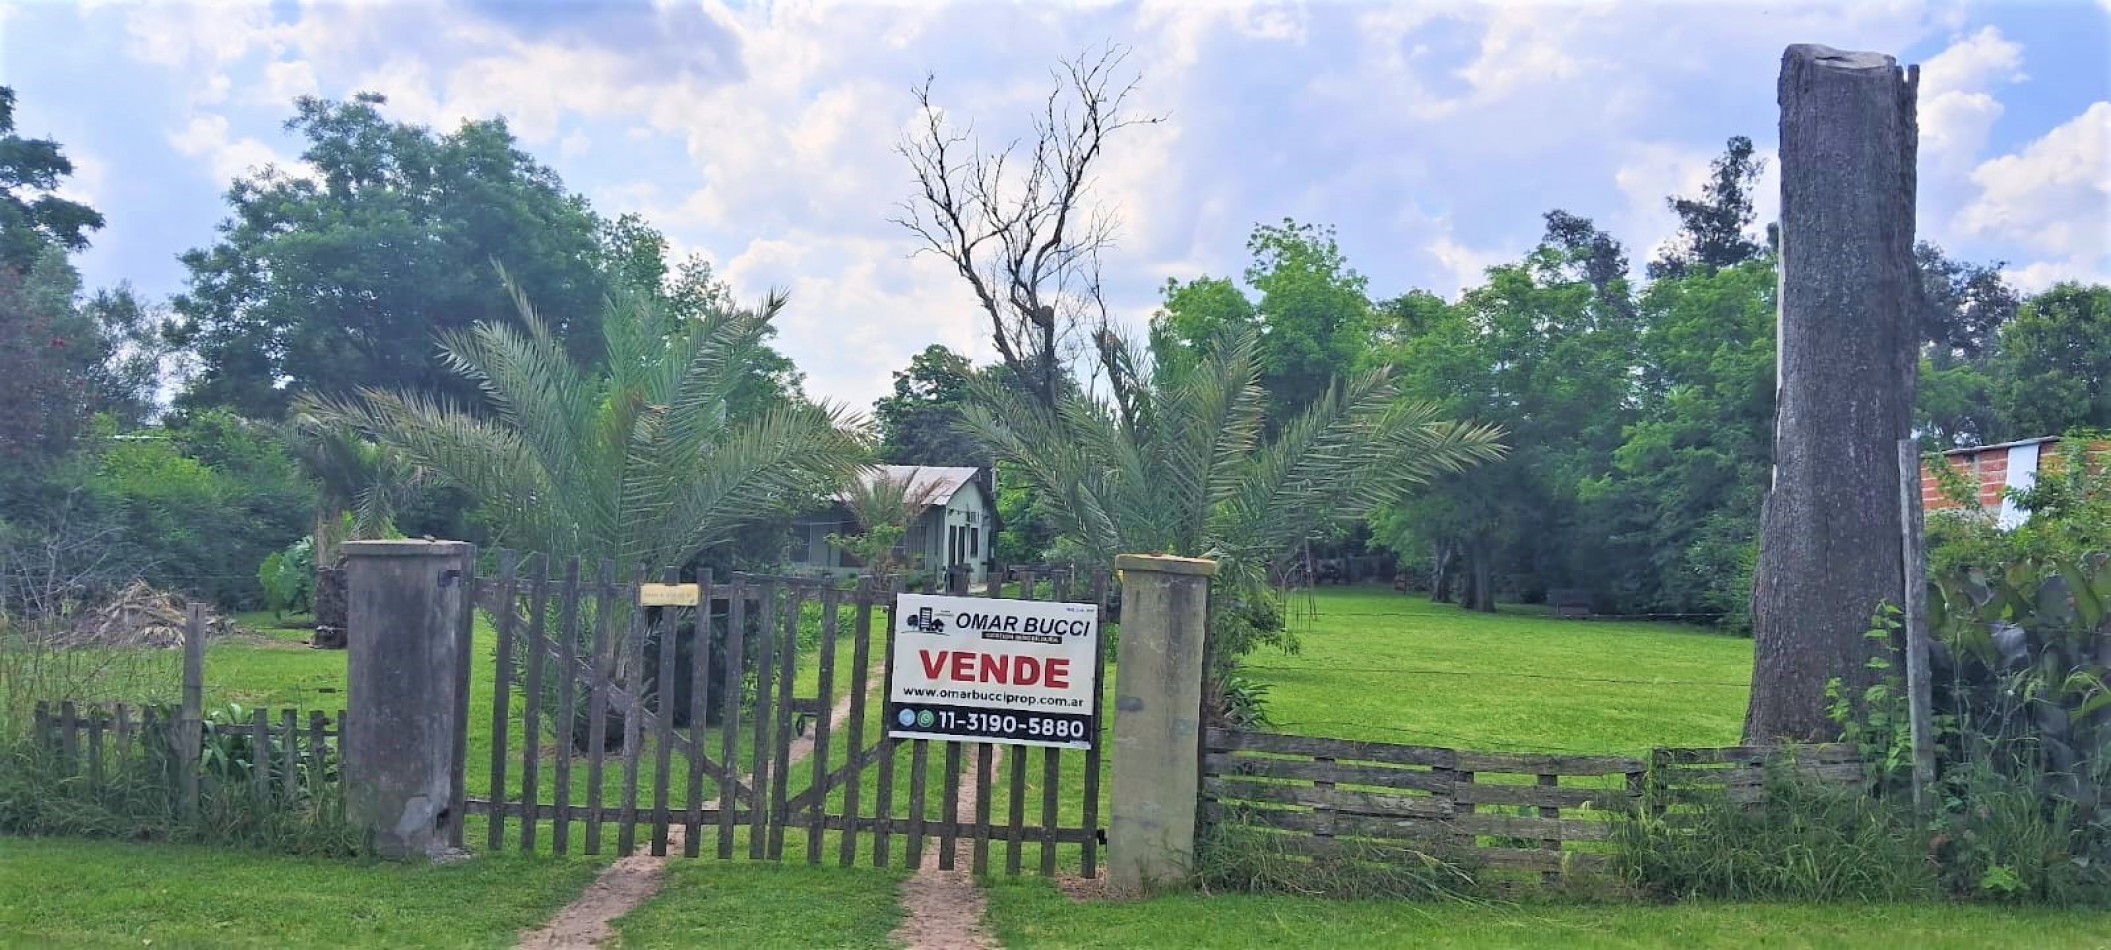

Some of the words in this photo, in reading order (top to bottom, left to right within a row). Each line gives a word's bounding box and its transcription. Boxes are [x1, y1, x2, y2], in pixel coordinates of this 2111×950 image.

[956, 613, 1018, 632] OMAR
[1023, 617, 1090, 637] BUCCI
[919, 649, 1070, 688] VENDE
[903, 687, 1084, 707] www.omarbucciprop.com.ar
[939, 710, 1084, 738] 11-3190-5880
